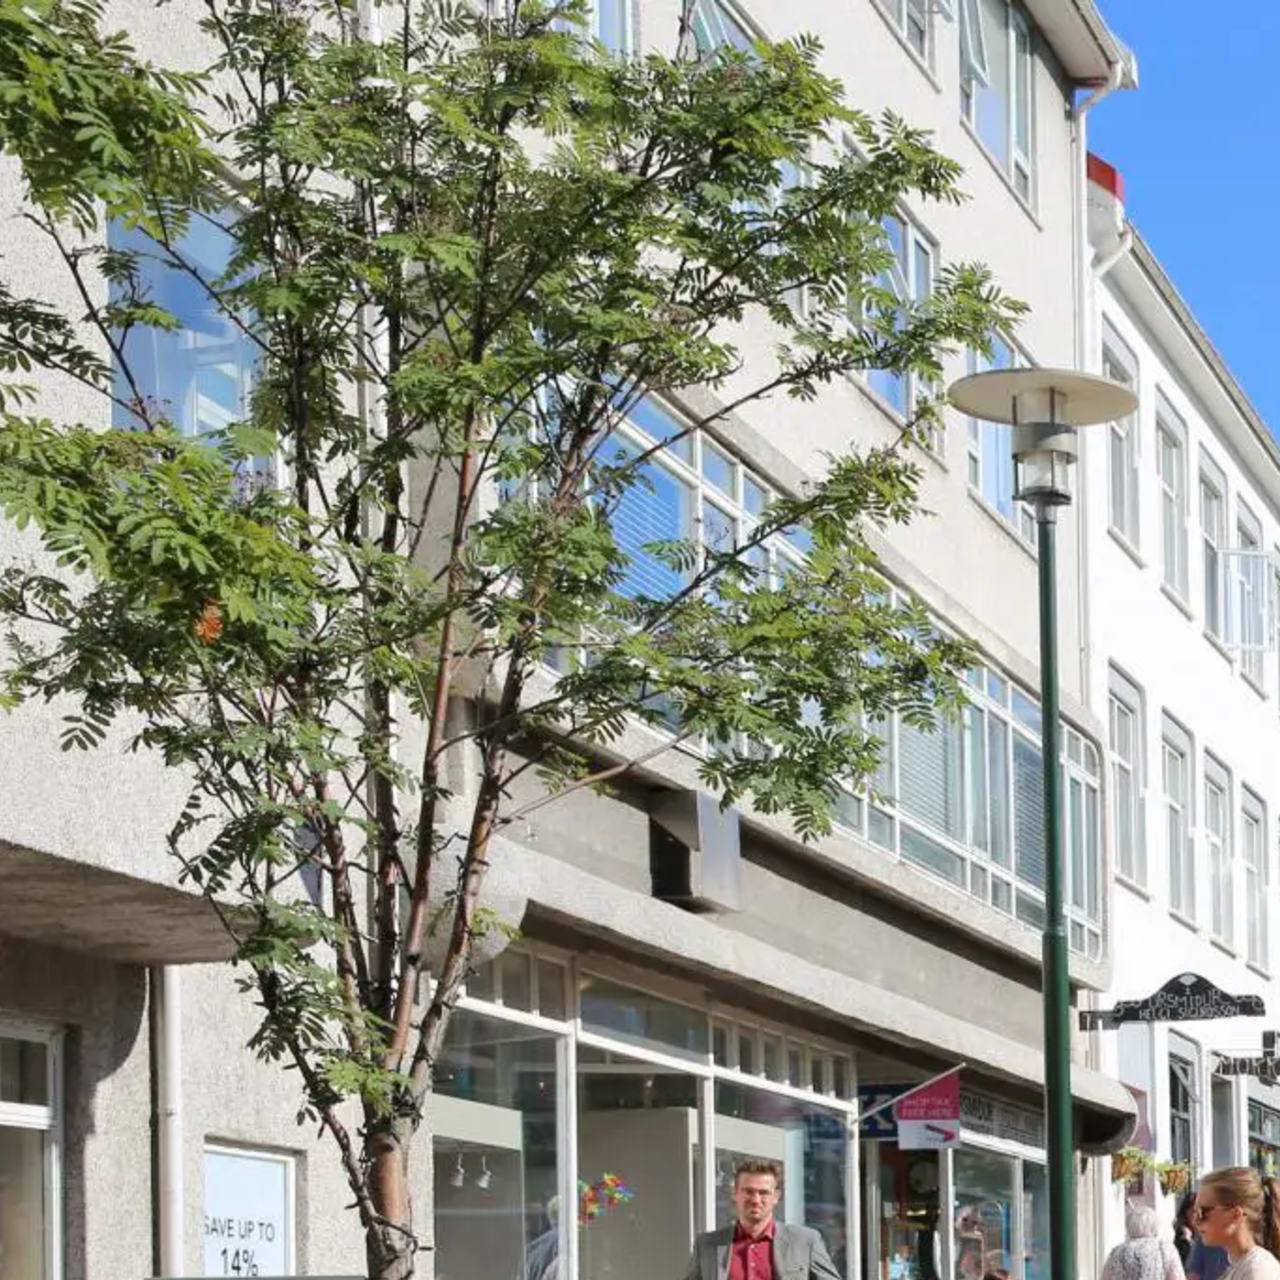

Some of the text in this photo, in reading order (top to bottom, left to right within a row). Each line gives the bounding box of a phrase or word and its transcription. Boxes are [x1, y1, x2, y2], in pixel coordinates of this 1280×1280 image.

[238, 1221, 254, 1239] UP
[258, 1222, 276, 1242] TO
[221, 1248, 259, 1276] 14%
